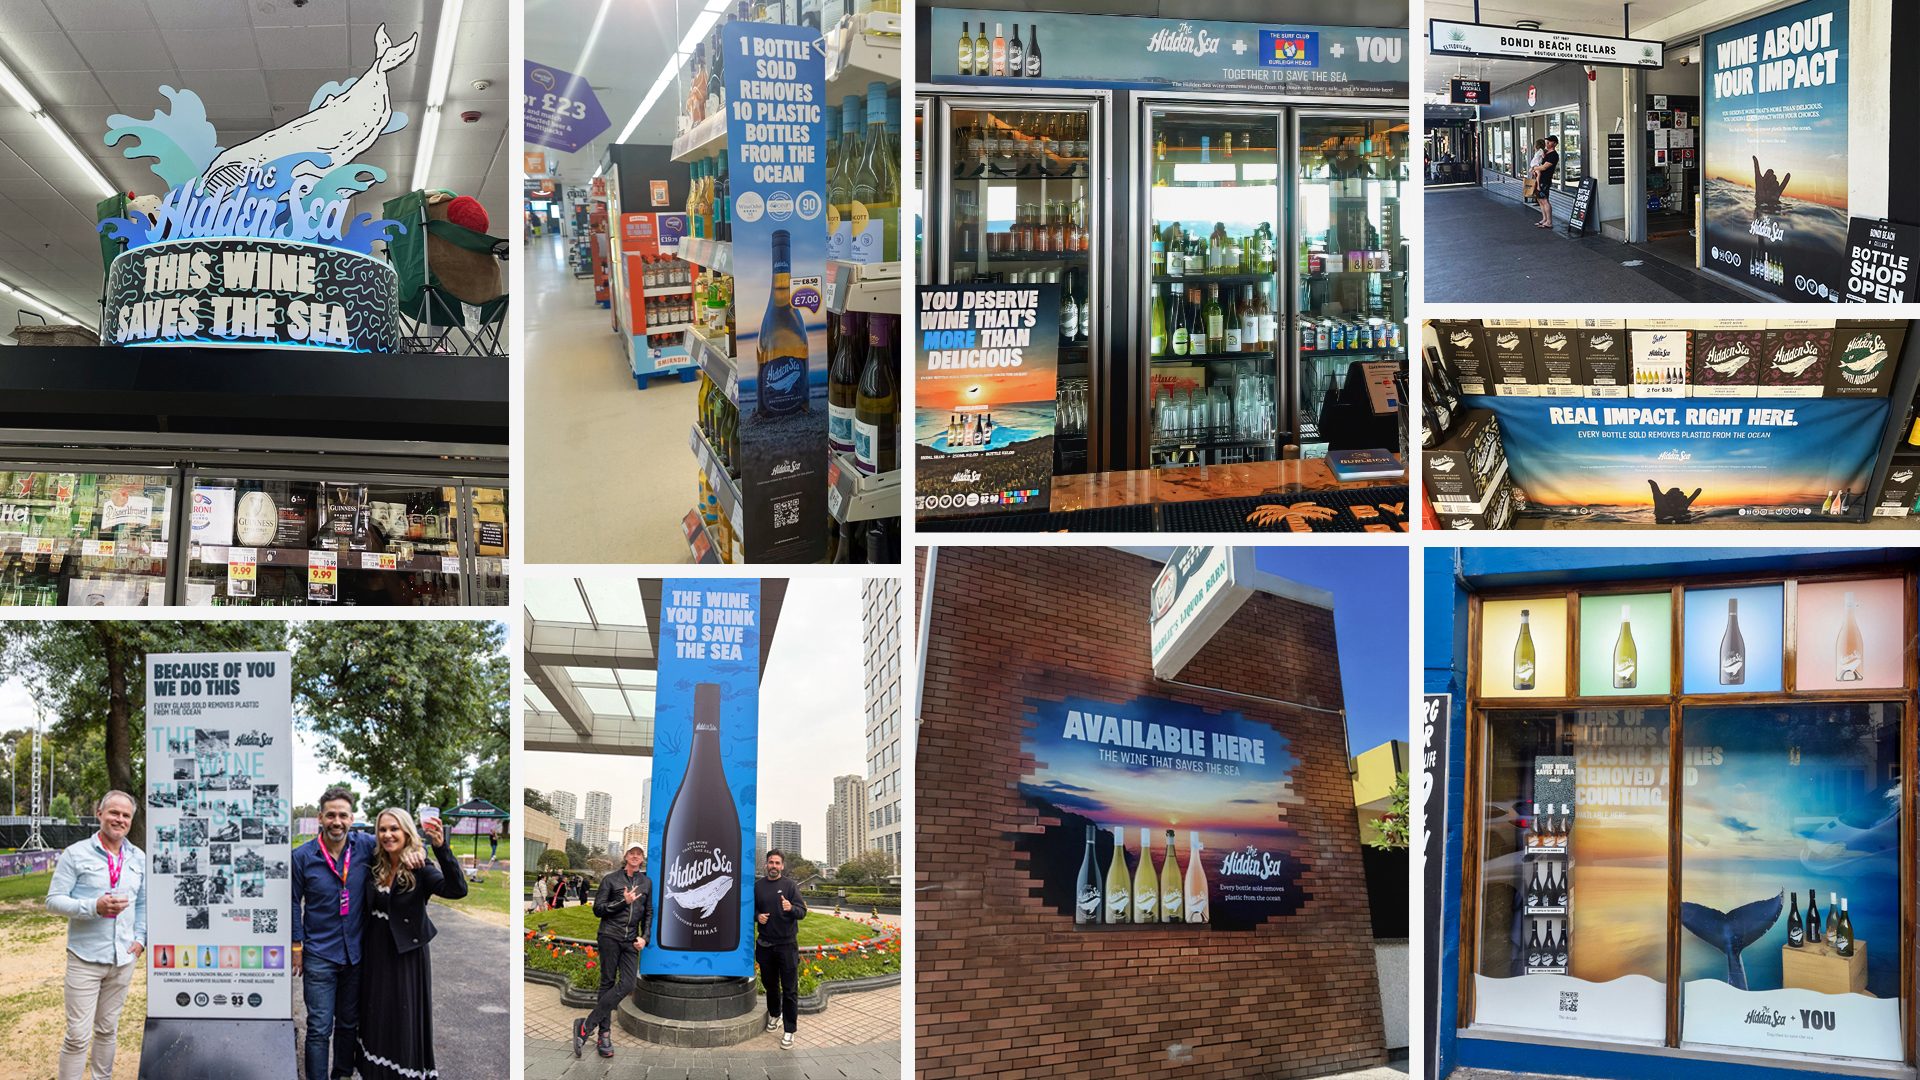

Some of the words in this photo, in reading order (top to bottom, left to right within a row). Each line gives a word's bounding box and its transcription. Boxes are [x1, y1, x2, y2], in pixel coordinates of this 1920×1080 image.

[1178, 22, 1193, 34] The
[740, 36, 748, 56] 1
[753, 37, 810, 60] BOTTLE
[1146, 28, 1196, 54] Hidden
[1193, 30, 1220, 57] Sea
[1356, 36, 1402, 64] YOU
[1500, 36, 1534, 48] BONDI
[1538, 39, 1571, 52] BEACH
[1575, 43, 1616, 55] CELLARS
[1716, 34, 1758, 70] WINE
[1762, 12, 1834, 61] ABOUT
[756, 60, 796, 80] SOLD
[1222, 68, 1270, 81] TOGETHER
[1272, 70, 1284, 81] TO
[1286, 70, 1309, 82] SAVE
[1311, 71, 1328, 82] THE
[1330, 71, 1348, 83] SEA
[1714, 67, 1754, 99] YOUR
[1759, 49, 1839, 94] IMPACT
[740, 80, 813, 102] REMOVES
[527, 108, 540, 116] and
[542, 94, 587, 120] £23
[733, 101, 753, 121] 10
[757, 102, 821, 124] PLASTIC
[746, 124, 810, 143] BOTTLES
[741, 145, 785, 163] FROM
[788, 145, 815, 163] THE
[241, 161, 276, 189] The
[753, 165, 805, 183] OCEAN
[149, 178, 284, 241] Hidden
[279, 178, 353, 240] Sea
[802, 198, 815, 210] 90
[1749, 219, 1772, 240] Hidden
[1770, 219, 1785, 242] Sea
[1882, 230, 1896, 241] BEACH
[1852, 246, 1910, 271] BOTTLE
[144, 254, 211, 294] THIS
[223, 252, 316, 293] WINE
[1850, 259, 1907, 287] SHOP
[794, 295, 819, 305] £7.00
[921, 291, 958, 310] YOU
[962, 290, 1039, 310] DESERVE
[1848, 278, 1904, 303] OPEN
[117, 300, 205, 343] SAVES
[213, 298, 276, 340] THE
[287, 301, 349, 345] SEA
[921, 311, 970, 330] WINE
[975, 309, 1037, 329] THAT'S
[923, 330, 976, 350] MORE
[981, 329, 1030, 348] THAN
[1844, 336, 1875, 353] Hidden
[1870, 335, 1886, 352] Sea
[928, 348, 1023, 370] DELICIOUS
[1706, 346, 1736, 364] Hidden
[1734, 341, 1750, 355] Sea
[1774, 346, 1804, 364] Hidden
[1802, 340, 1818, 355] Sea
[657, 357, 688, 367] SMIRNOFF
[1549, 407, 1598, 425] REAL
[1603, 407, 1680, 425] IMPACT.
[1686, 408, 1743, 426] RIGHT
[1746, 408, 1798, 426] HERE.
[1578, 430, 1600, 439] EVERY
[1602, 430, 1627, 439] BOTTLE
[1629, 430, 1646, 439] SOLD
[1648, 431, 1680, 439] REMOVES
[1681, 431, 1711, 439] PLASTIC
[1713, 431, 1731, 439] FROM
[1733, 431, 1746, 439] THE
[1747, 431, 1771, 439] OCEAN
[1658, 450, 1680, 461] Hidden
[1679, 450, 1692, 461] Sea
[233, 567, 251, 575] 9.99
[313, 570, 332, 579] 9.99
[672, 591, 701, 606] THE
[706, 592, 749, 608] WINE
[1180, 588, 1204, 624] LIQUOR
[1206, 560, 1225, 593] BARN
[666, 607, 697, 623] YOU
[702, 609, 755, 626] DRINK
[676, 625, 697, 640] TO
[702, 626, 743, 643] SAVE
[676, 642, 705, 659] THE
[710, 643, 743, 660] SEA
[154, 663, 218, 679] BECAUSE
[223, 662, 242, 678] OF
[247, 662, 275, 678] YOU
[154, 680, 176, 696] WE
[180, 680, 202, 696] DO
[206, 679, 240, 696] THIS
[182, 708, 201, 716] OCEAN
[208, 701, 234, 709] REMOVES
[235, 701, 259, 709] PLASTIC
[1578, 710, 1619, 726] TENS
[1623, 709, 1645, 726] OF
[234, 734, 260, 747] Hidden
[259, 732, 274, 748] Sea
[1063, 711, 1205, 757] AVAILABLE
[1212, 732, 1265, 765] HERE
[1099, 749, 1118, 762] THE
[1121, 753, 1148, 766] WINE
[1151, 756, 1173, 769] THAT
[1175, 759, 1203, 772] SAVES
[1206, 762, 1222, 775] THE
[1224, 765, 1240, 777] SEA
[1576, 747, 1645, 765] PLASTIC
[1576, 767, 1655, 786] REMOVED
[1576, 787, 1667, 806] COUNTING.
[1246, 845, 1257, 857] The
[668, 855, 712, 888] Hidden
[711, 848, 732, 874] Sea
[1220, 852, 1261, 876] Hidden
[1260, 853, 1281, 880] Sea
[1220, 884, 1234, 892] Every
[1225, 894, 1242, 902] plastic
[694, 927, 718, 935] SHIRAZ
[231, 995, 244, 1006] 93
[1744, 1009, 1773, 1026] Hidden
[1771, 1010, 1786, 1028] Sea
[1800, 1009, 1836, 1031] YOU
